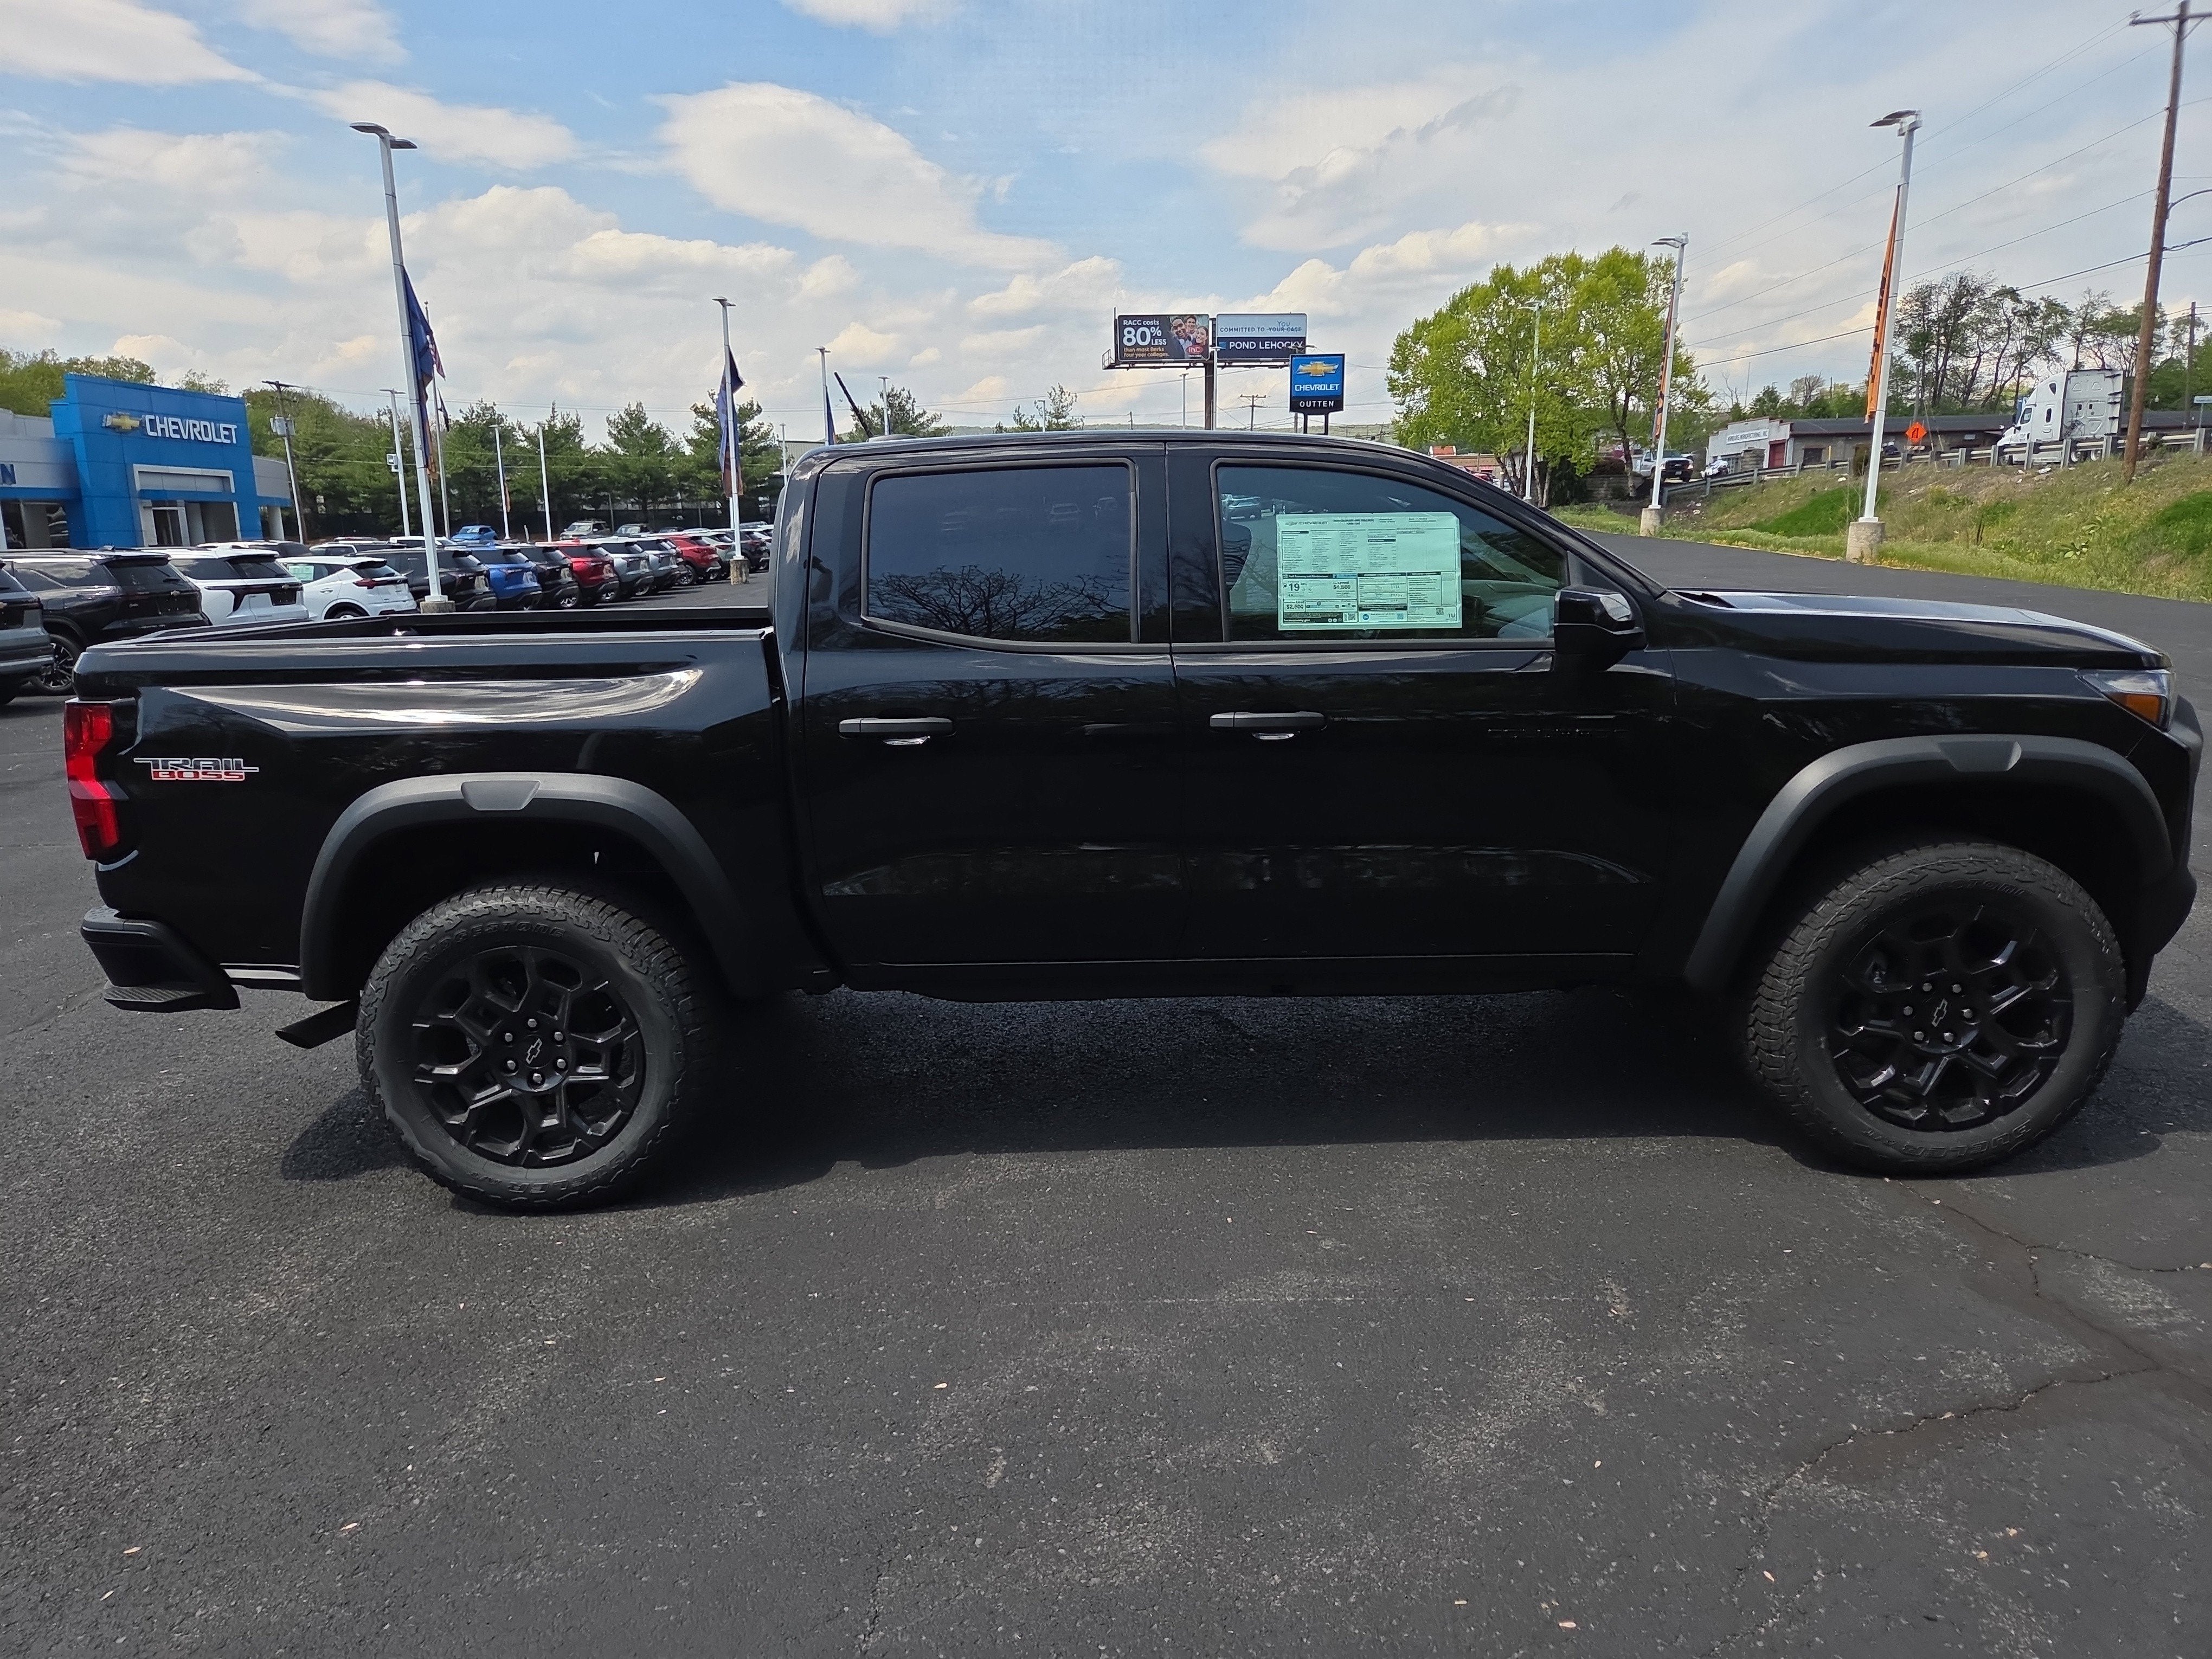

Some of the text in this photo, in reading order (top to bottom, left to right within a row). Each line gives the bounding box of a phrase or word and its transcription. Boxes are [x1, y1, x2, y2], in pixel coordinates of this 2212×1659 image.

[1229, 342, 1256, 350] POND
[145, 414, 237, 444] CHEVROLET
[1289, 583, 1300, 591] 19
[133, 757, 259, 772] TRAIL
[151, 770, 245, 781] BOSS
[507, 1150, 627, 1194] DUELER
